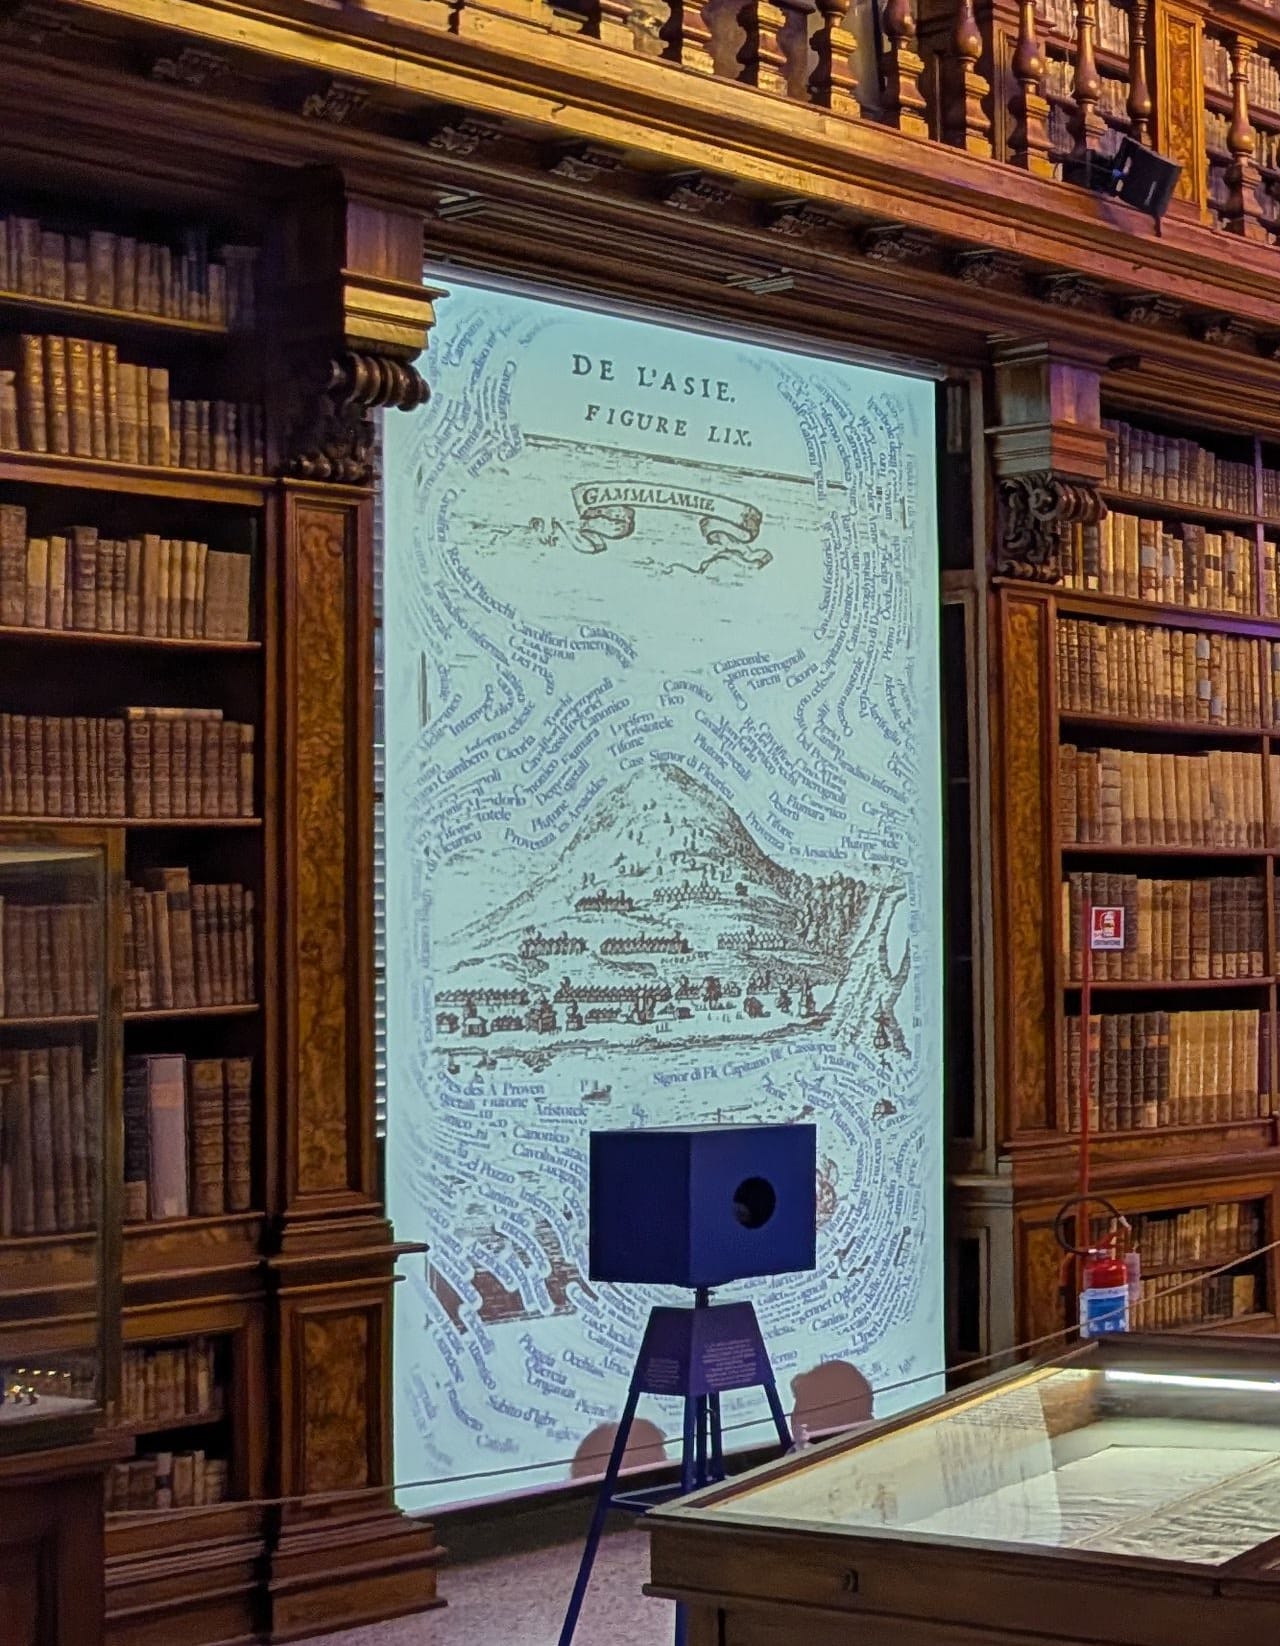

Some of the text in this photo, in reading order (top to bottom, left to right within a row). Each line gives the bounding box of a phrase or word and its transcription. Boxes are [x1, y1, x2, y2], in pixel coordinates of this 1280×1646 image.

[572, 353, 736, 403] DE L'ASIE.
[585, 404, 752, 447] FIGURE LIX.
